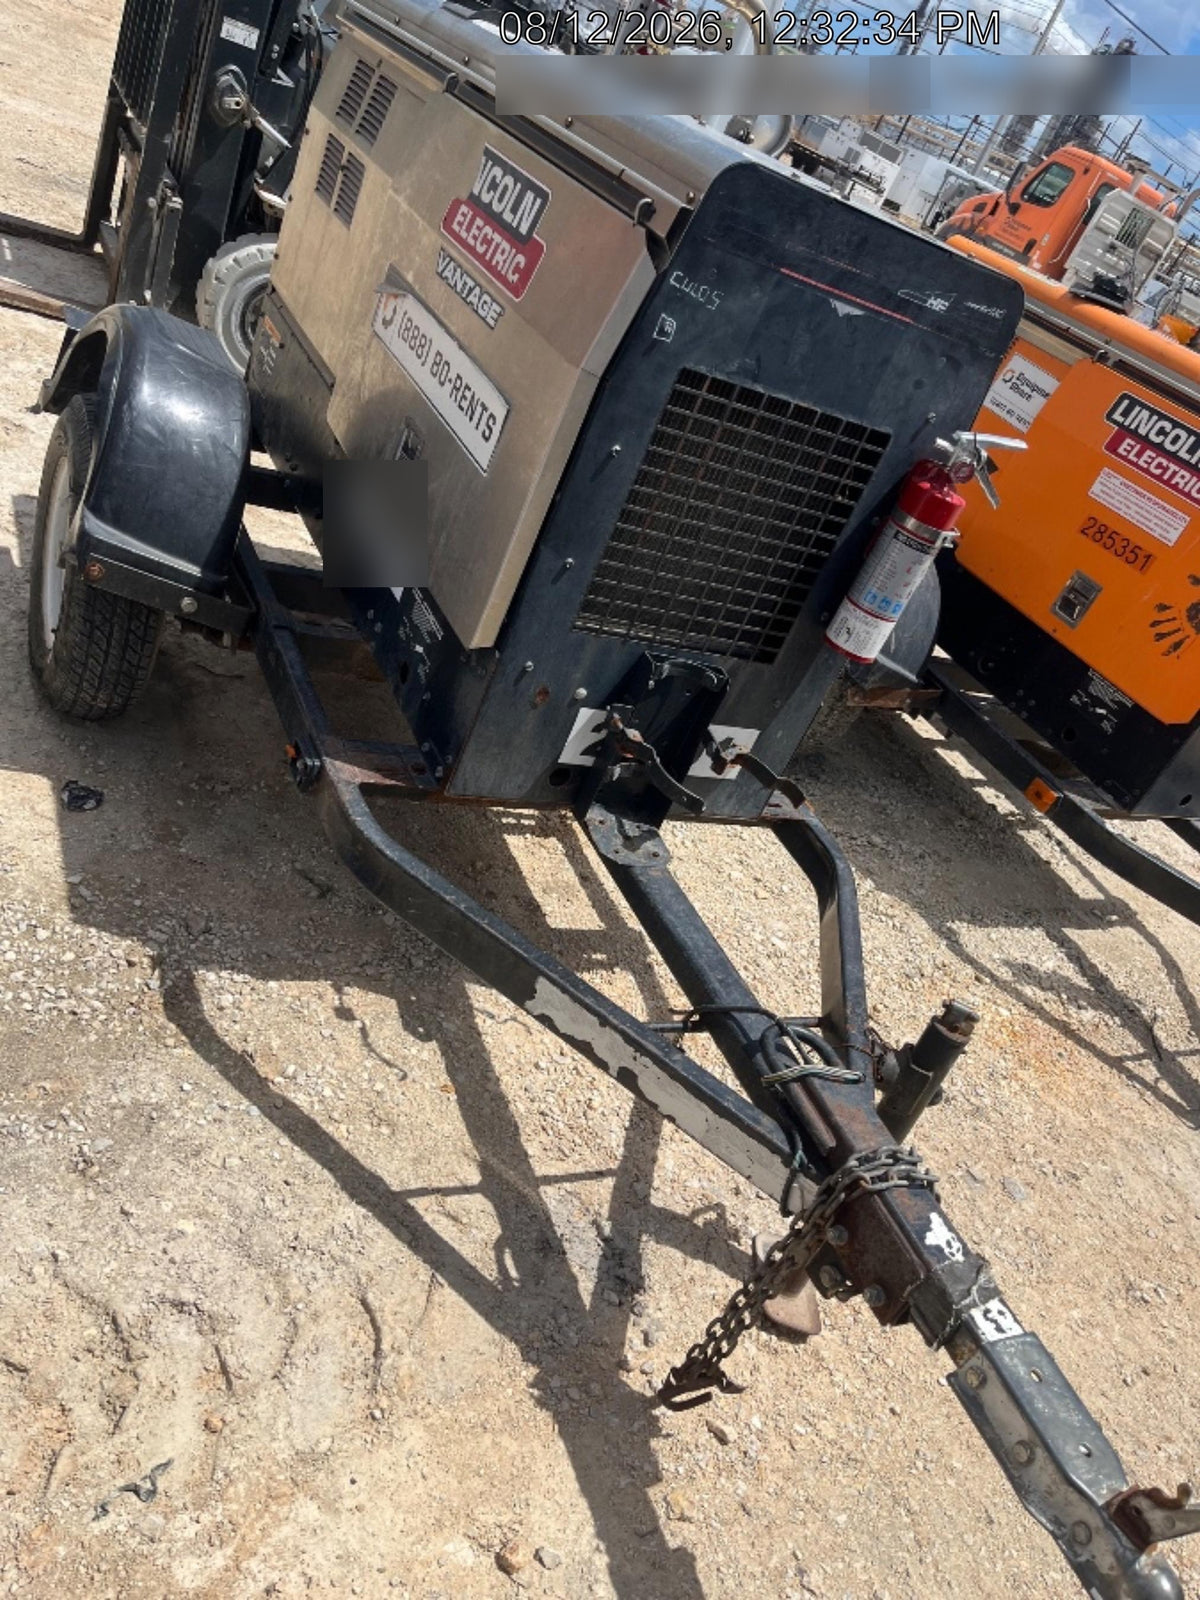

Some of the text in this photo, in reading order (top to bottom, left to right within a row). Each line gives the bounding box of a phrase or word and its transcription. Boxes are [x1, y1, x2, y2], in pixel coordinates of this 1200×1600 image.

[471, 156, 542, 236] NCOLN
[451, 203, 526, 284] ELECTRIC
[438, 250, 502, 329] VANTAGE
[397, 309, 433, 367] (888)
[1080, 516, 1154, 572] 285351
